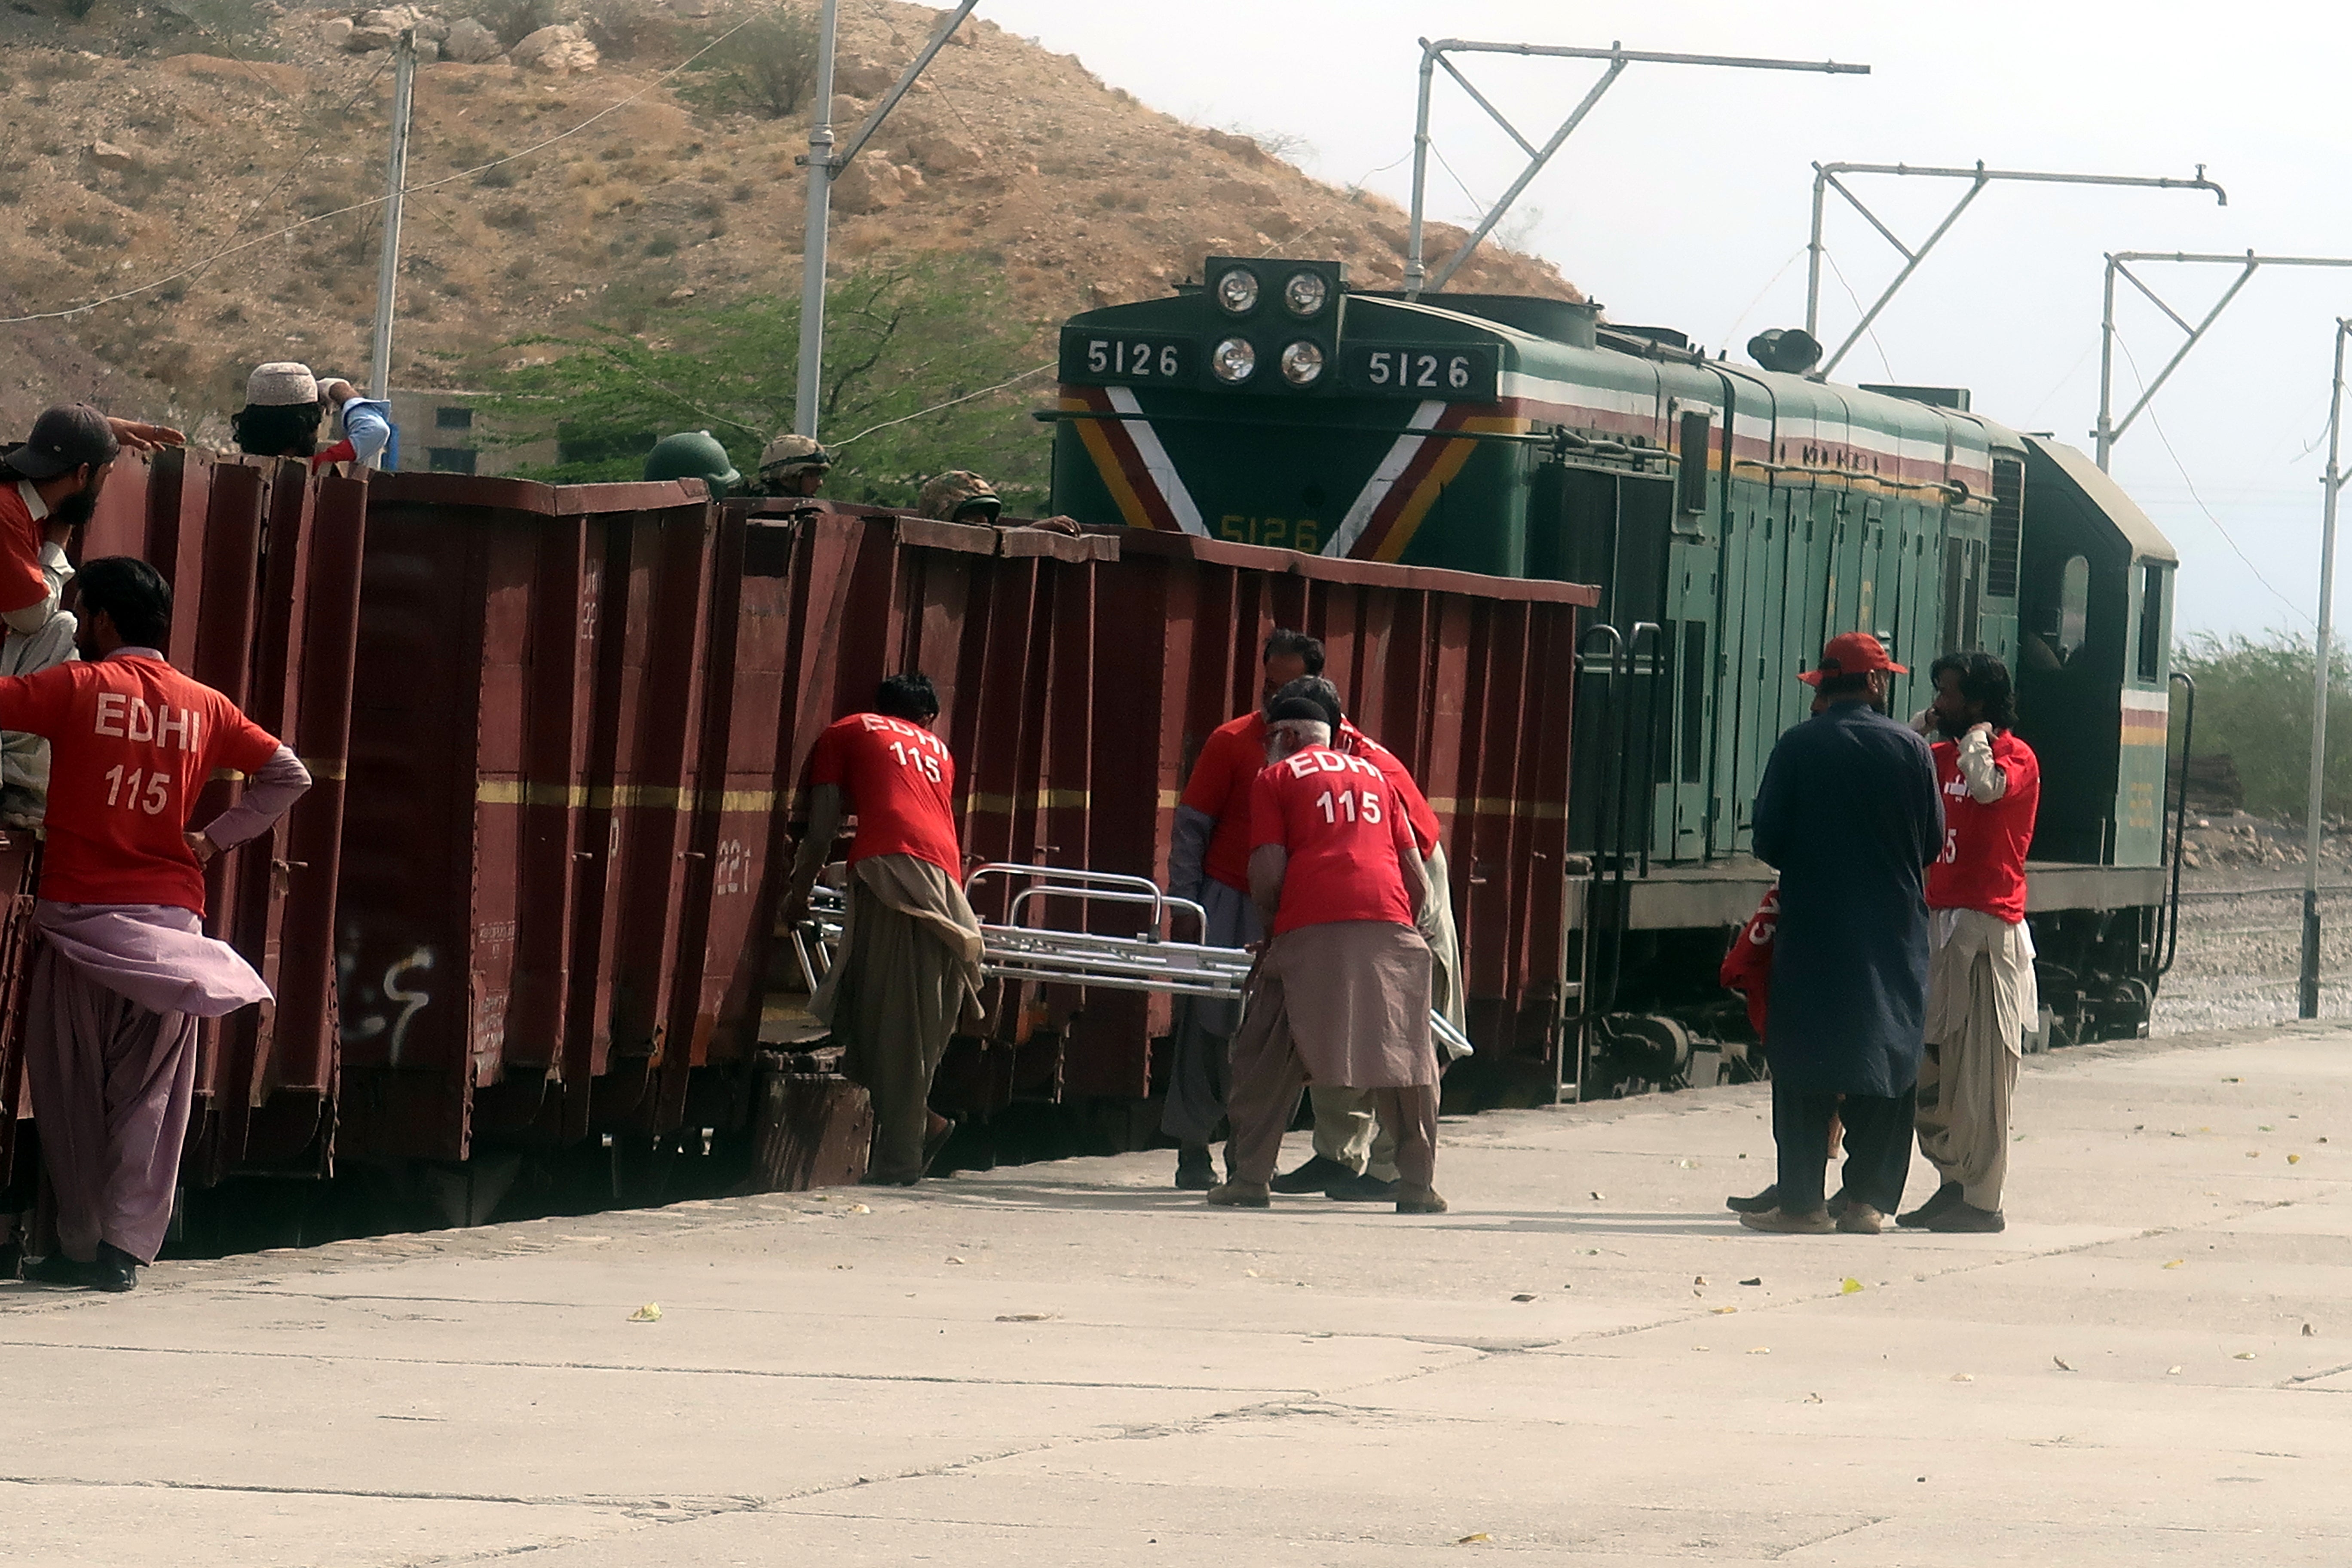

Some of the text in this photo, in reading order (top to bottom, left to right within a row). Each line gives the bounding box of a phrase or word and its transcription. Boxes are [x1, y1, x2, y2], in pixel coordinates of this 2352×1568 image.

[1088, 340, 1178, 377] 5126
[1369, 352, 1469, 389] 5126
[1222, 515, 1317, 553] 5126
[95, 692, 200, 753] EDHI
[860, 712, 949, 762] EDHI
[889, 741, 941, 783] 115
[1286, 750, 1384, 779] EDHI
[105, 764, 171, 815] 115
[1316, 790, 1381, 824] 115
